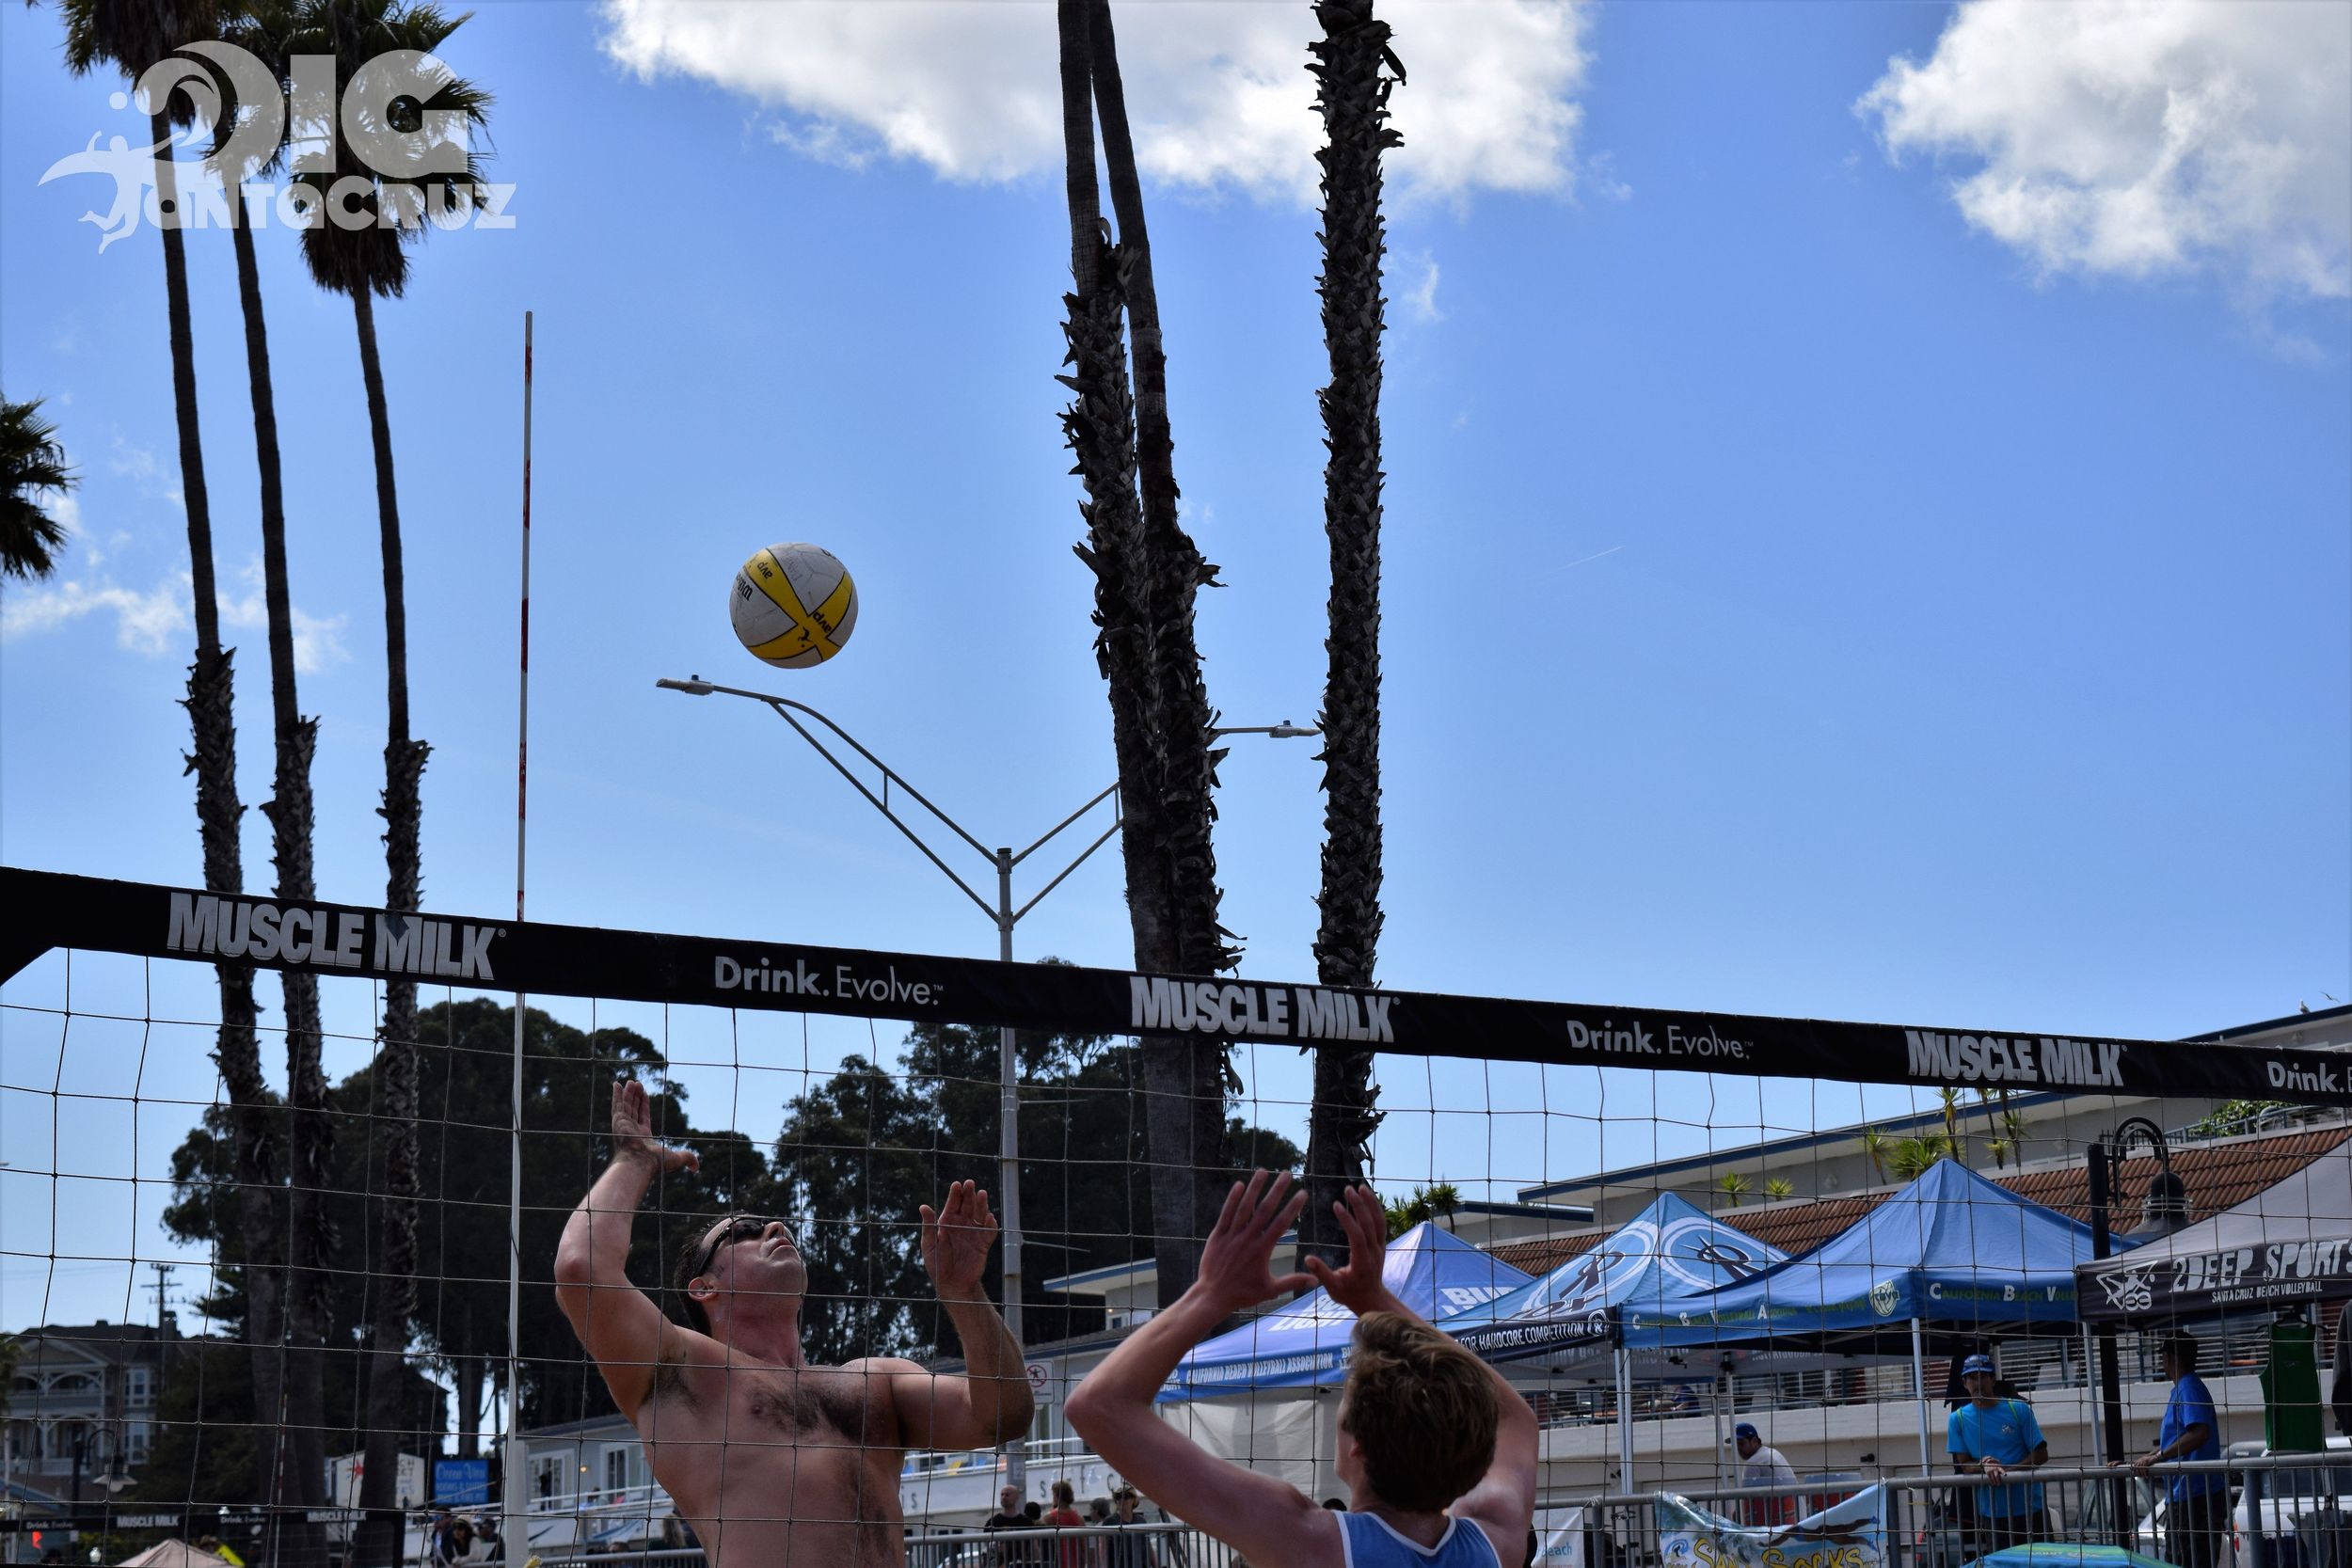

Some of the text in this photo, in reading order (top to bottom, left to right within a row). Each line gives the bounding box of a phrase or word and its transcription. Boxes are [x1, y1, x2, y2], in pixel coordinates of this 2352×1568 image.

[812, 611, 833, 633] avp
[167, 892, 364, 968] MUSCLE
[714, 956, 830, 997] Drink.
[1129, 975, 1289, 1036] MUSCLE
[1565, 1020, 1662, 1054] Drink.
[1904, 1030, 2038, 1082] MUSCLE
[2266, 1061, 2344, 1093] Drink.
[2169, 1247, 2254, 1293] 2DEEP
[2211, 1280, 2323, 1304] SANTA CRUZ BEACH VOLLEYBALL
[1461, 1322, 1585, 1352] FOR HARDCORE COMPETITION
[1185, 1365, 1224, 1385] CALIFORNIA
[1225, 1364, 1247, 1381] BEACH
[1248, 1358, 1286, 1378] VOLLEYBALL
[1286, 1353, 1334, 1374] ASSOCIATION
[117, 1514, 153, 1528] MUSCLE
[307, 1511, 342, 1522] MUSCLE
